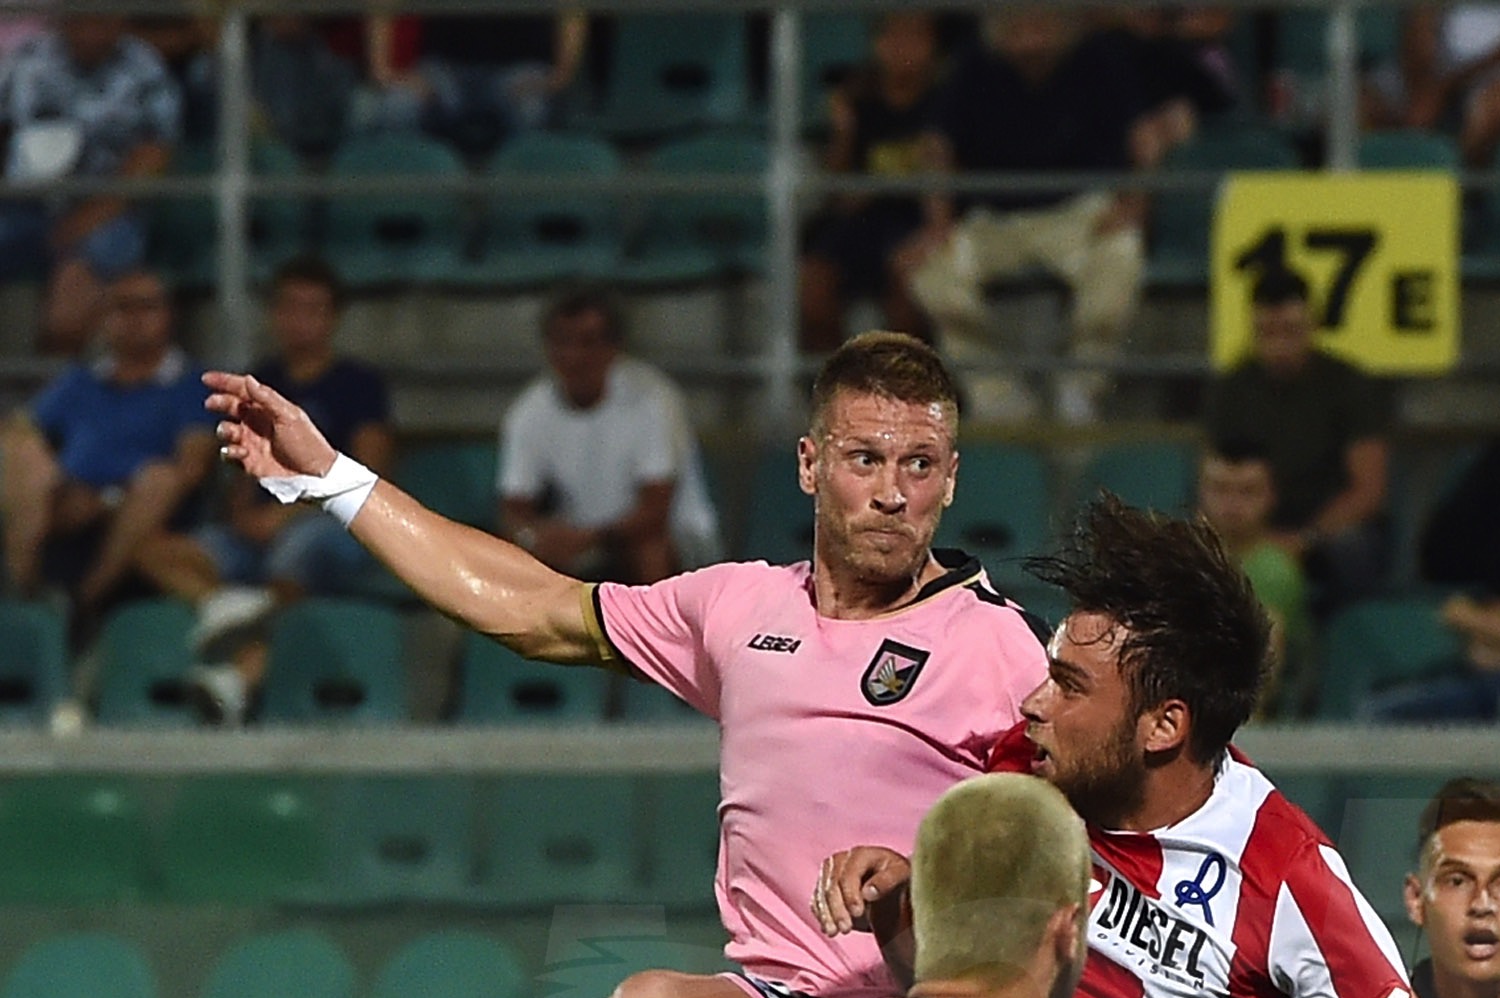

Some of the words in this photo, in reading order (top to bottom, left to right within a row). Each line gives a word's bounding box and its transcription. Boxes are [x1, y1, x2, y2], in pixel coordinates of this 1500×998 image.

[1392, 269, 1435, 332] E
[748, 633, 802, 654] LEGEA
[1096, 876, 1208, 980] DIESEL
